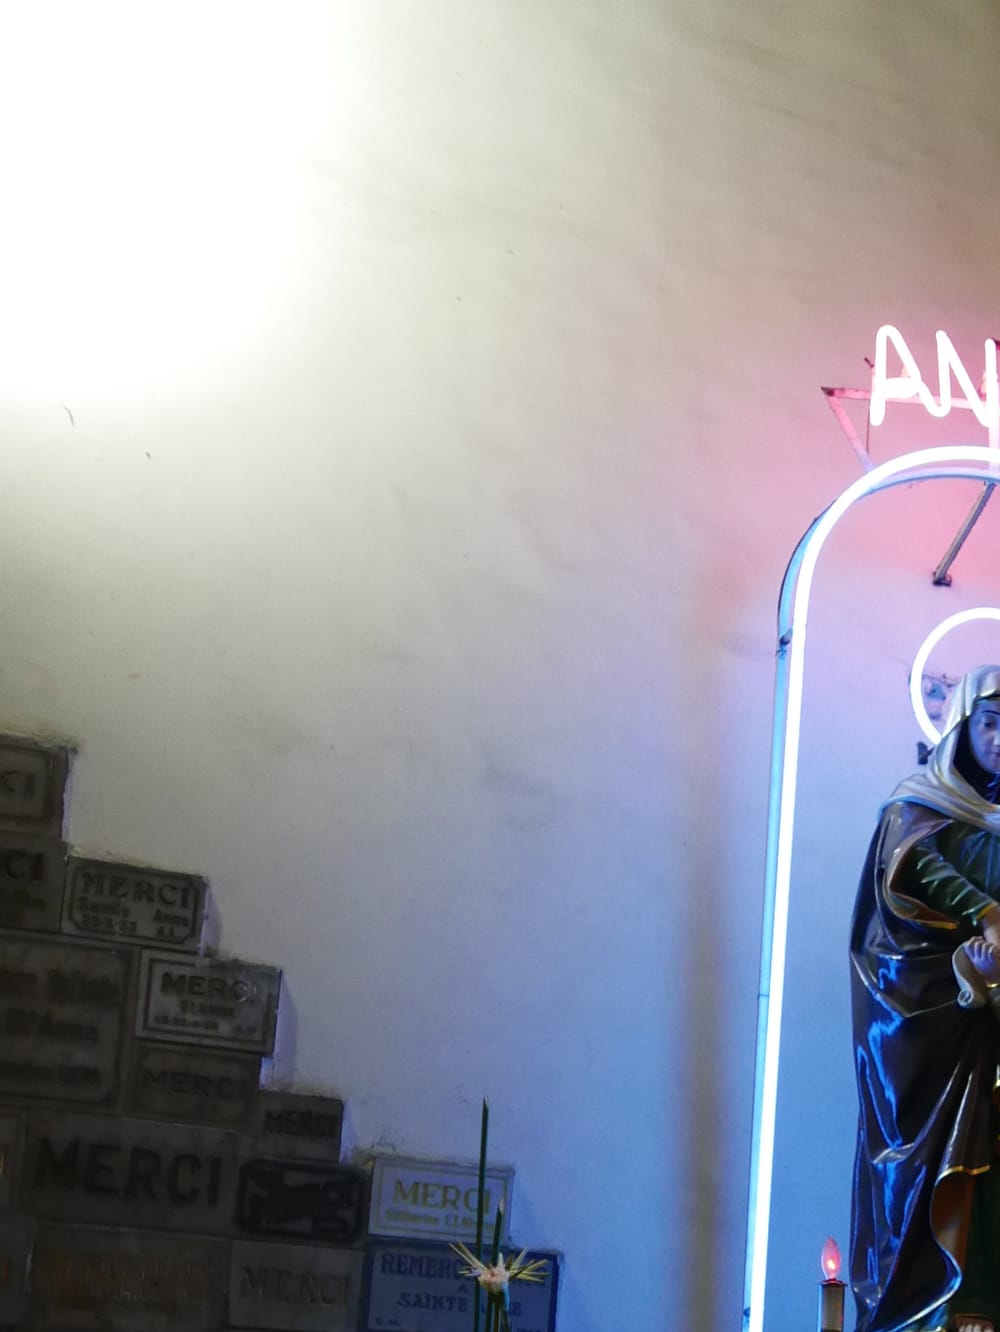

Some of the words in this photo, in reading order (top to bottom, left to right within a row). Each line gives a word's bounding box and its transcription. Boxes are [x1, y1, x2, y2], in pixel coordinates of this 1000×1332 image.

[82, 871, 190, 908] MERCI
[31, 1136, 222, 1208] MERCI
[393, 1178, 491, 1215] MERCI
[398, 1291, 468, 1313] SAINTE
